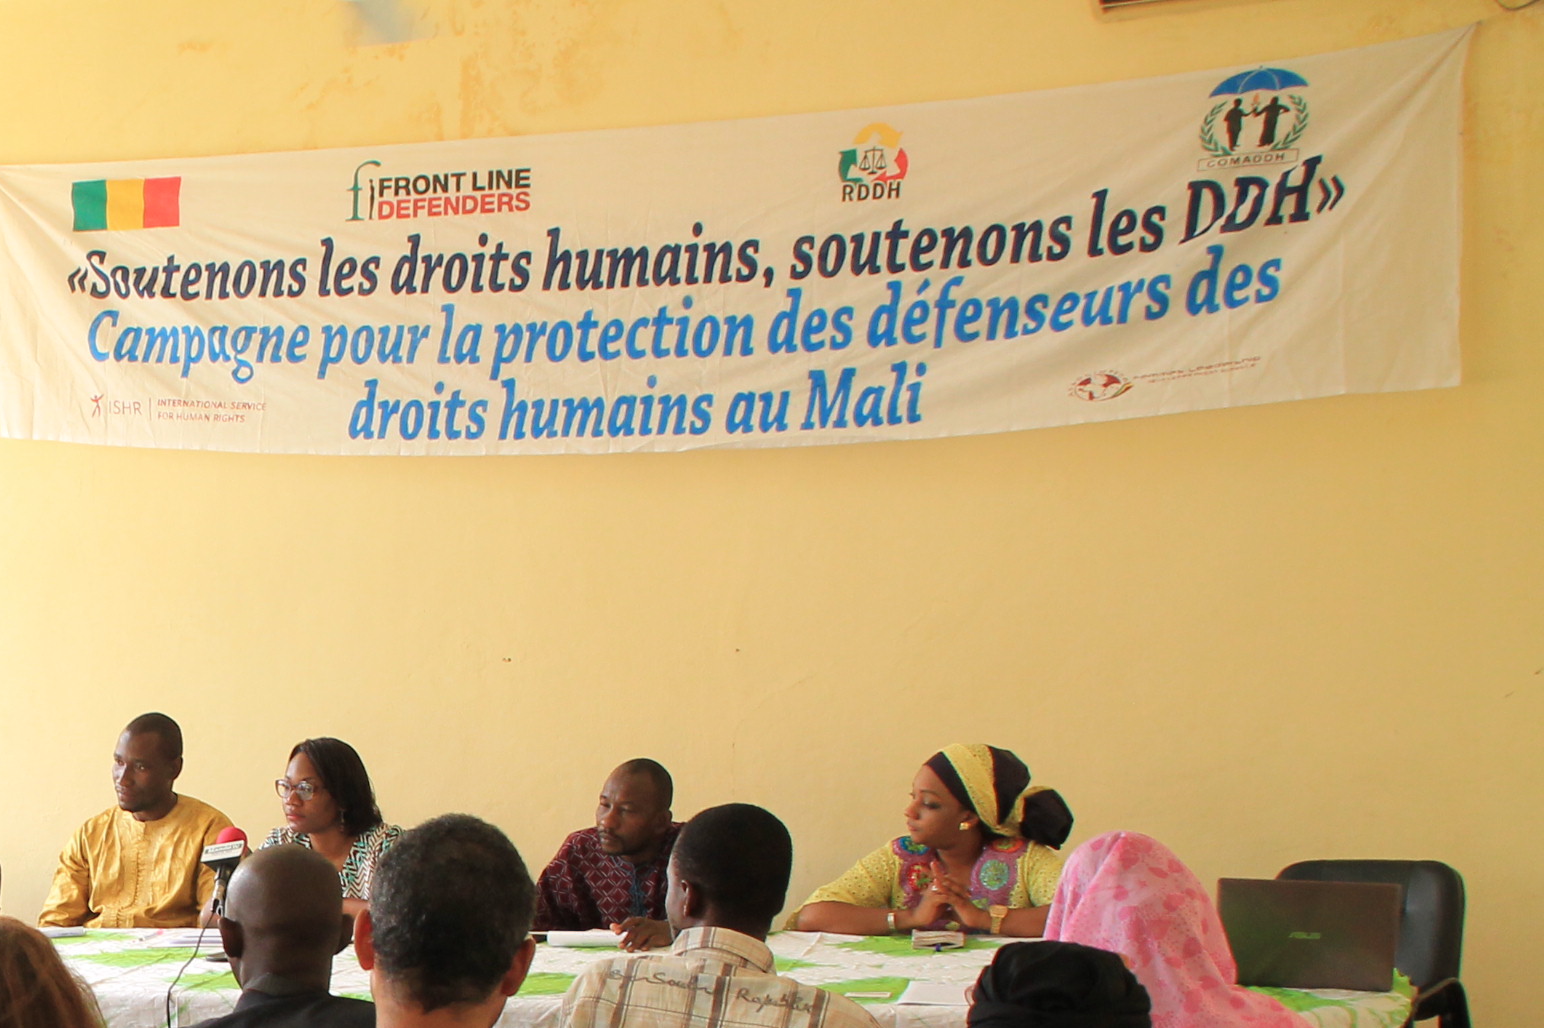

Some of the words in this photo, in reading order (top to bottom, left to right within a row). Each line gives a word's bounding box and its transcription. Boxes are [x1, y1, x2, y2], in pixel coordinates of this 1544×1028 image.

[378, 171, 468, 198] FRONT
[471, 168, 532, 192] LINE
[841, 181, 901, 202] RDDH
[377, 191, 532, 221] DEFENDERS
[318, 237, 381, 297] les
[390, 231, 532, 296] droits
[542, 222, 774, 291] humains,
[790, 215, 1074, 281] soutenons
[1087, 188, 1167, 258] les
[88, 309, 311, 384] Campagne
[318, 324, 431, 379] pour
[438, 303, 484, 364] la
[491, 298, 756, 380] protection
[768, 287, 855, 353] des
[867, 275, 1172, 350] défenseurs
[1184, 244, 1282, 318] des
[108, 400, 143, 416] ISHR
[157, 399, 228, 410] INTERNATIONAL
[231, 401, 267, 412] SERVICE
[348, 378, 488, 440] droits
[498, 375, 716, 440] humains
[726, 391, 791, 434] au
[802, 361, 929, 431] Mali
[157, 412, 174, 421] FOR
[176, 412, 211, 422] HUMAN
[214, 413, 246, 424] RIGHTS
